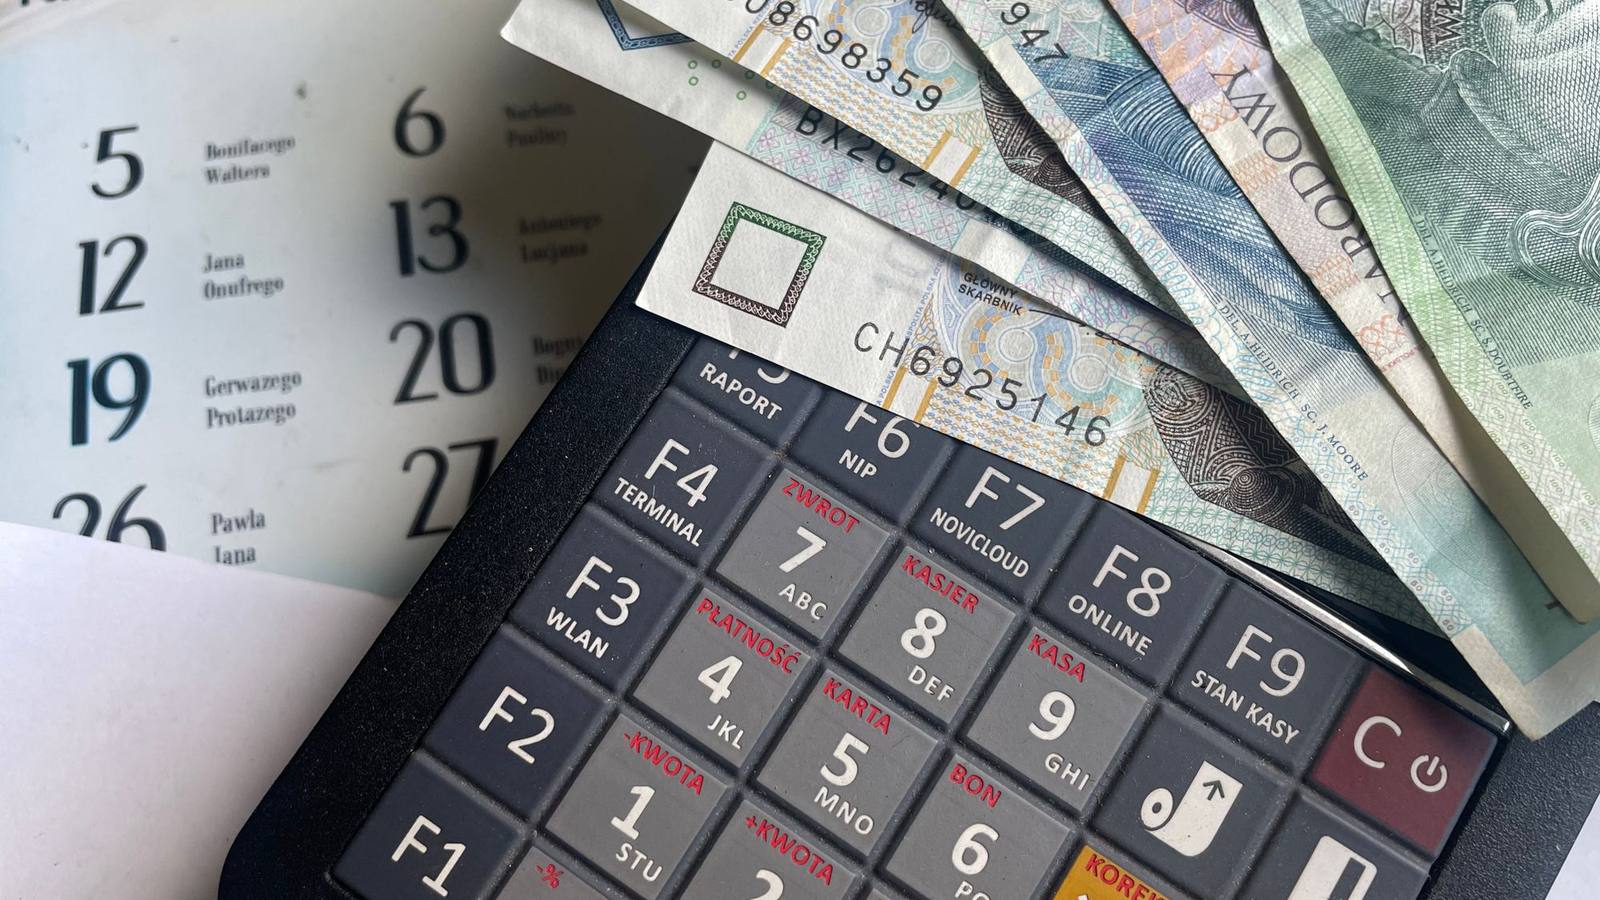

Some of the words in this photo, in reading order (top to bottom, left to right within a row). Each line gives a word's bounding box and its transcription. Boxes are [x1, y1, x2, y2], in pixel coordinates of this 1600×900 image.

[394, 85, 446, 158] 6
[90, 124, 145, 200] 5
[1209, 64, 1408, 326] RODOWY
[204, 254, 245, 273] Jana
[389, 195, 471, 278] 13
[78, 234, 149, 316] 12
[204, 277, 284, 300] Onufrego
[957, 284, 1023, 316] SKARBNIK
[1415, 219, 1431, 246] DEL.
[1434, 257, 1475, 314] HEIDRICH
[1487, 348, 1534, 410] DOUBTFIRE
[204, 371, 302, 398] Gerwazego
[389, 311, 497, 405] 20
[853, 321, 1112, 447] CH6925146
[65, 351, 152, 447] 19
[206, 402, 297, 430] Protazego
[699, 361, 783, 420] RAPORT
[1219, 305, 1239, 331] DEL.
[1240, 331, 1250, 345] A.
[1250, 342, 1300, 400] HEIDRICH
[1301, 403, 1317, 424] SC.
[1317, 423, 1327, 435] J.
[1327, 434, 1369, 481] MOORE
[844, 402, 921, 459] F6
[401, 436, 499, 540] 27
[643, 438, 719, 508] F4
[838, 449, 878, 479] NIP
[52, 483, 167, 552] 26
[613, 476, 705, 548] TERMINAL
[783, 476, 861, 535] ZWROT
[964, 466, 1046, 530] F7
[778, 525, 827, 574] 7
[930, 507, 1030, 578] NOVICLOUD
[565, 555, 641, 626] F3
[778, 583, 827, 621] ABC
[902, 554, 981, 615] KASJER
[1092, 544, 1172, 617] F8
[545, 605, 610, 659] WLAN
[696, 597, 803, 674] PŁATNOŚĆ
[900, 607, 948, 659] 8
[1068, 594, 1153, 657] ONLINE
[697, 655, 744, 705] 4
[907, 665, 955, 702] DEF
[1028, 633, 1087, 684] KASA
[1225, 624, 1306, 697] F9
[478, 685, 555, 765] F2
[707, 714, 745, 750] JKL
[823, 677, 894, 736] KARTA
[1028, 690, 1076, 742] 9
[1191, 669, 1244, 713] STAN
[1245, 702, 1299, 745] KASY
[623, 730, 705, 796] -KWOTA
[819, 731, 870, 787] 5
[1044, 752, 1091, 792] GHI
[1353, 715, 1402, 769] C
[610, 784, 656, 840] 1
[814, 786, 875, 835] MNO
[949, 763, 1003, 809] BON
[390, 815, 467, 898] F1
[615, 842, 664, 882] STU
[744, 815, 834, 887] +KWOTA
[951, 822, 1000, 876] 6
